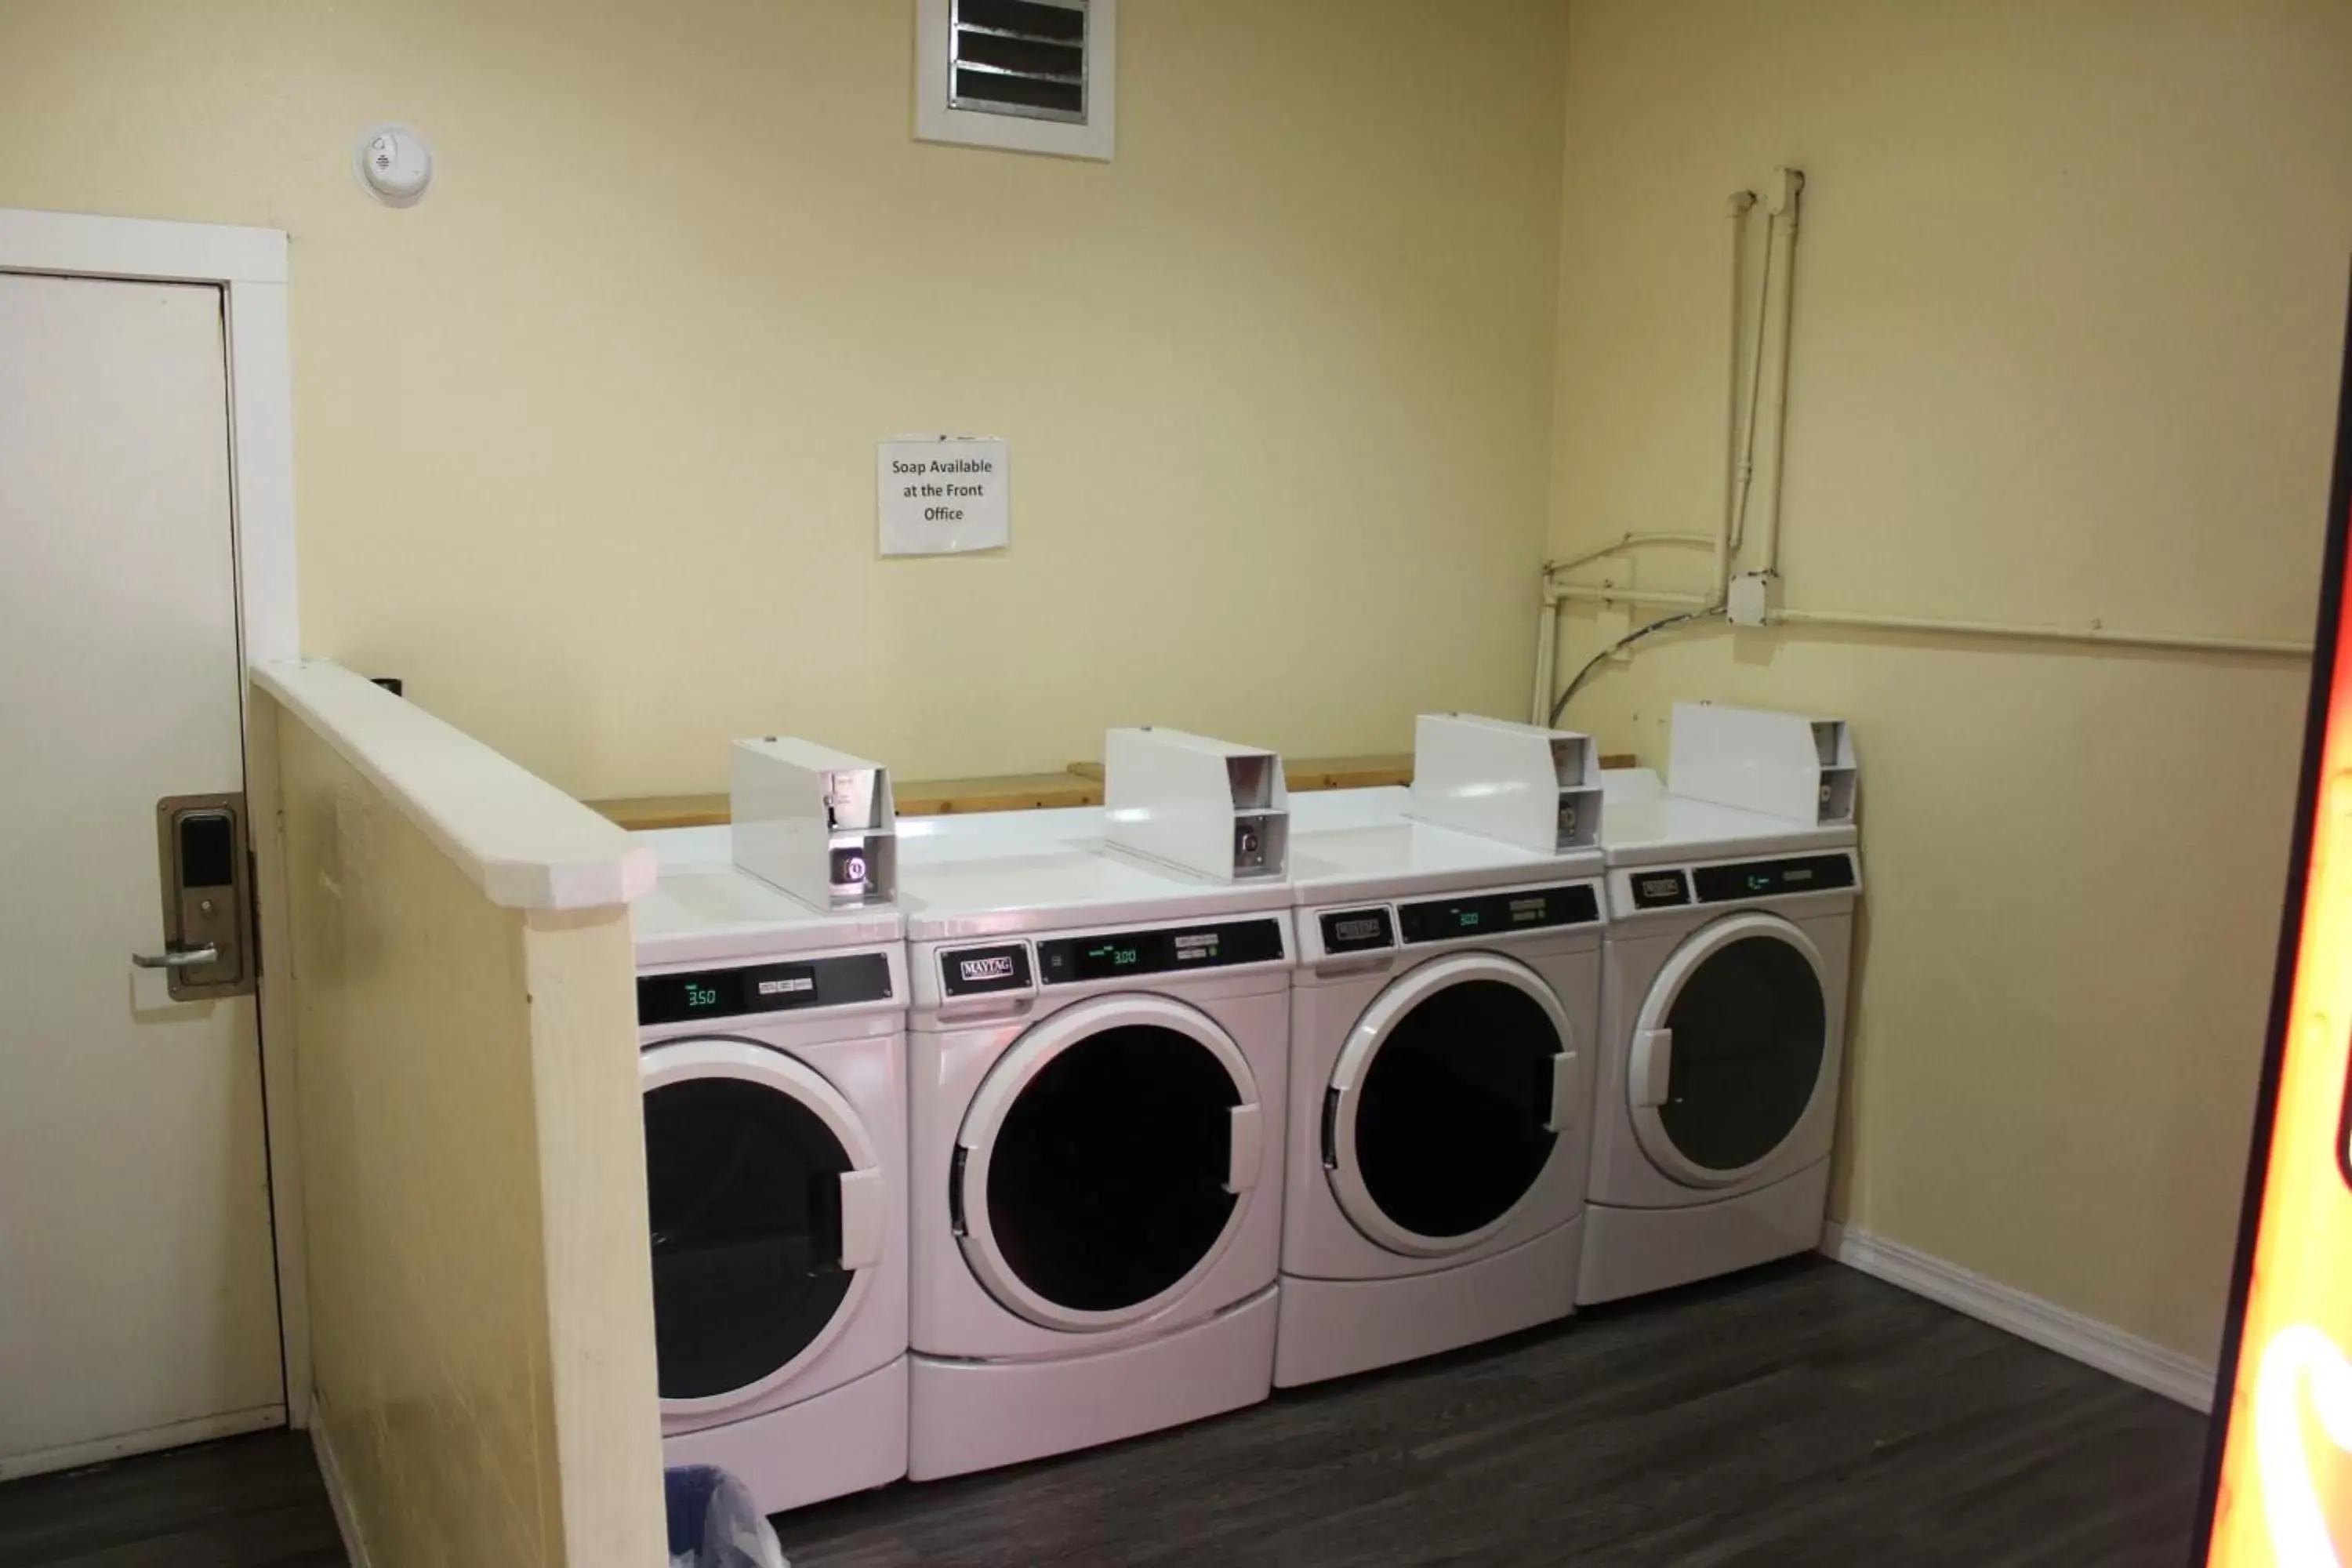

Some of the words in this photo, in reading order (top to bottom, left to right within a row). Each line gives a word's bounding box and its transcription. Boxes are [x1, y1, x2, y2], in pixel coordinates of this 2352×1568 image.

[892, 460, 926, 475] Soap
[930, 458, 993, 473] Available
[904, 485, 918, 498] at
[921, 484, 943, 497] the
[946, 483, 983, 497] Front
[924, 506, 964, 521] Office
[964, 959, 1010, 975] MAYTAG
